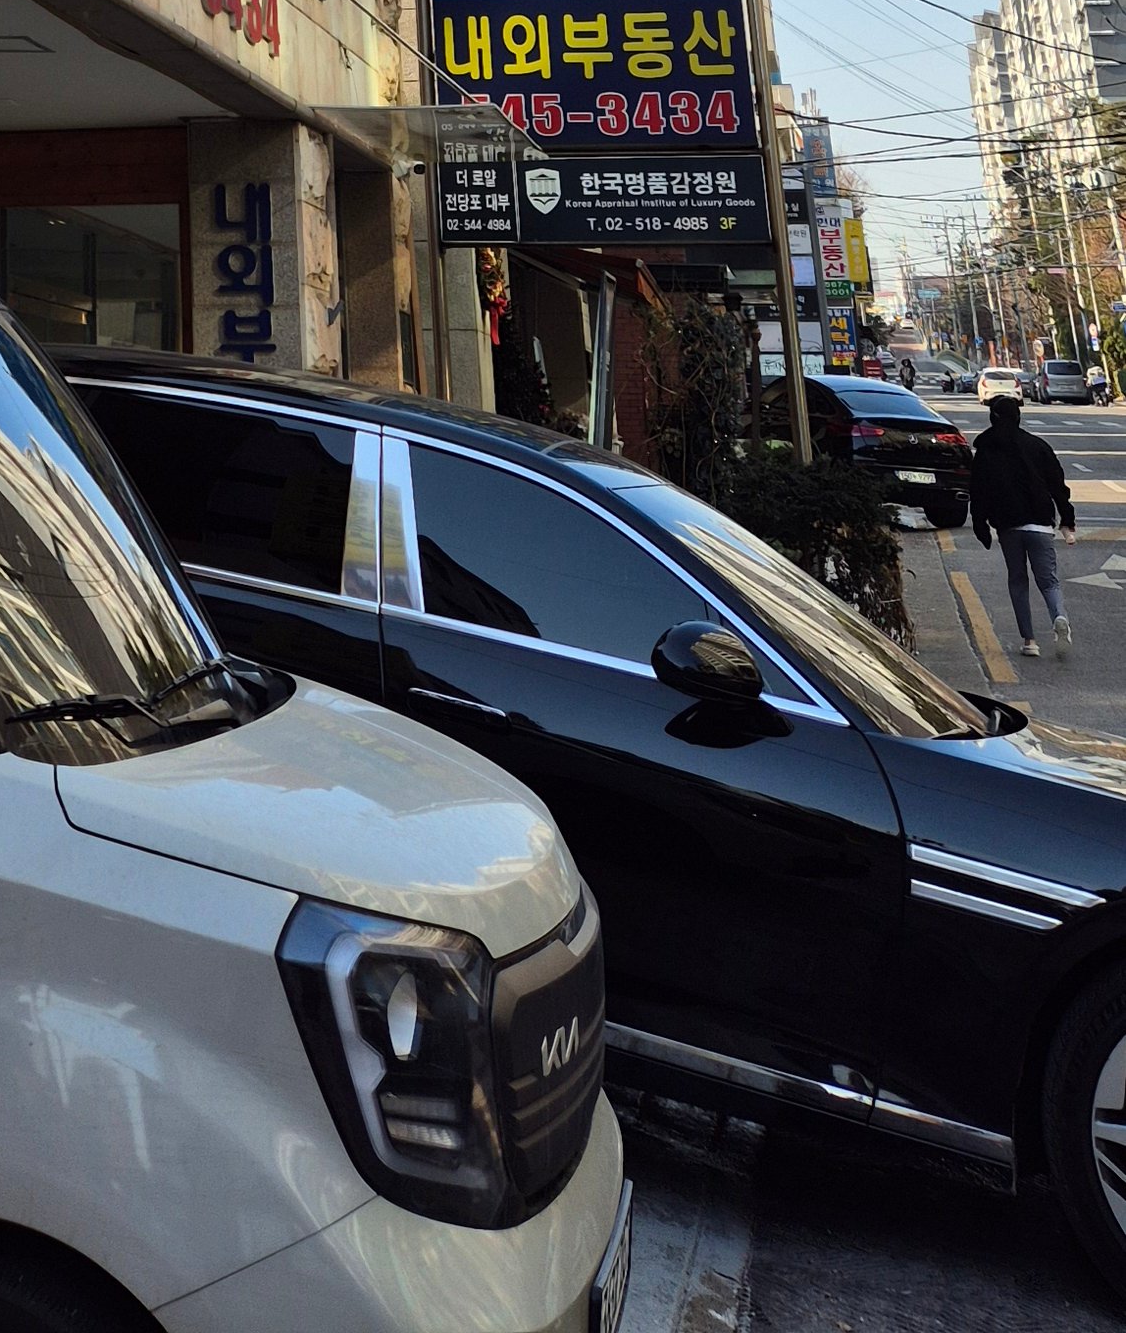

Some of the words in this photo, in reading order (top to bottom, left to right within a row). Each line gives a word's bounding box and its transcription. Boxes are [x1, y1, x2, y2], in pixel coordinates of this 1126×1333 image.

[443, 9, 737, 80] 내외부동산
[460, 89, 741, 137] 45-3434
[456, 169, 468, 188] 더
[579, 171, 738, 196] 한국명품감정원
[445, 193, 482, 212] 전당포
[485, 193, 511, 212] 대부
[565, 199, 592, 208] Korea
[595, 199, 638, 208] Appraisal
[679, 198, 689, 207] of
[691, 198, 723, 208] Luxury
[725, 198, 756, 207] Goods
[446, 218, 512, 231] 02-544-4984
[719, 217, 738, 230] 3F
[819, 229, 846, 278] 부동산
[214, 183, 277, 364] 내외부
[541, 1016, 579, 1077] KIA
